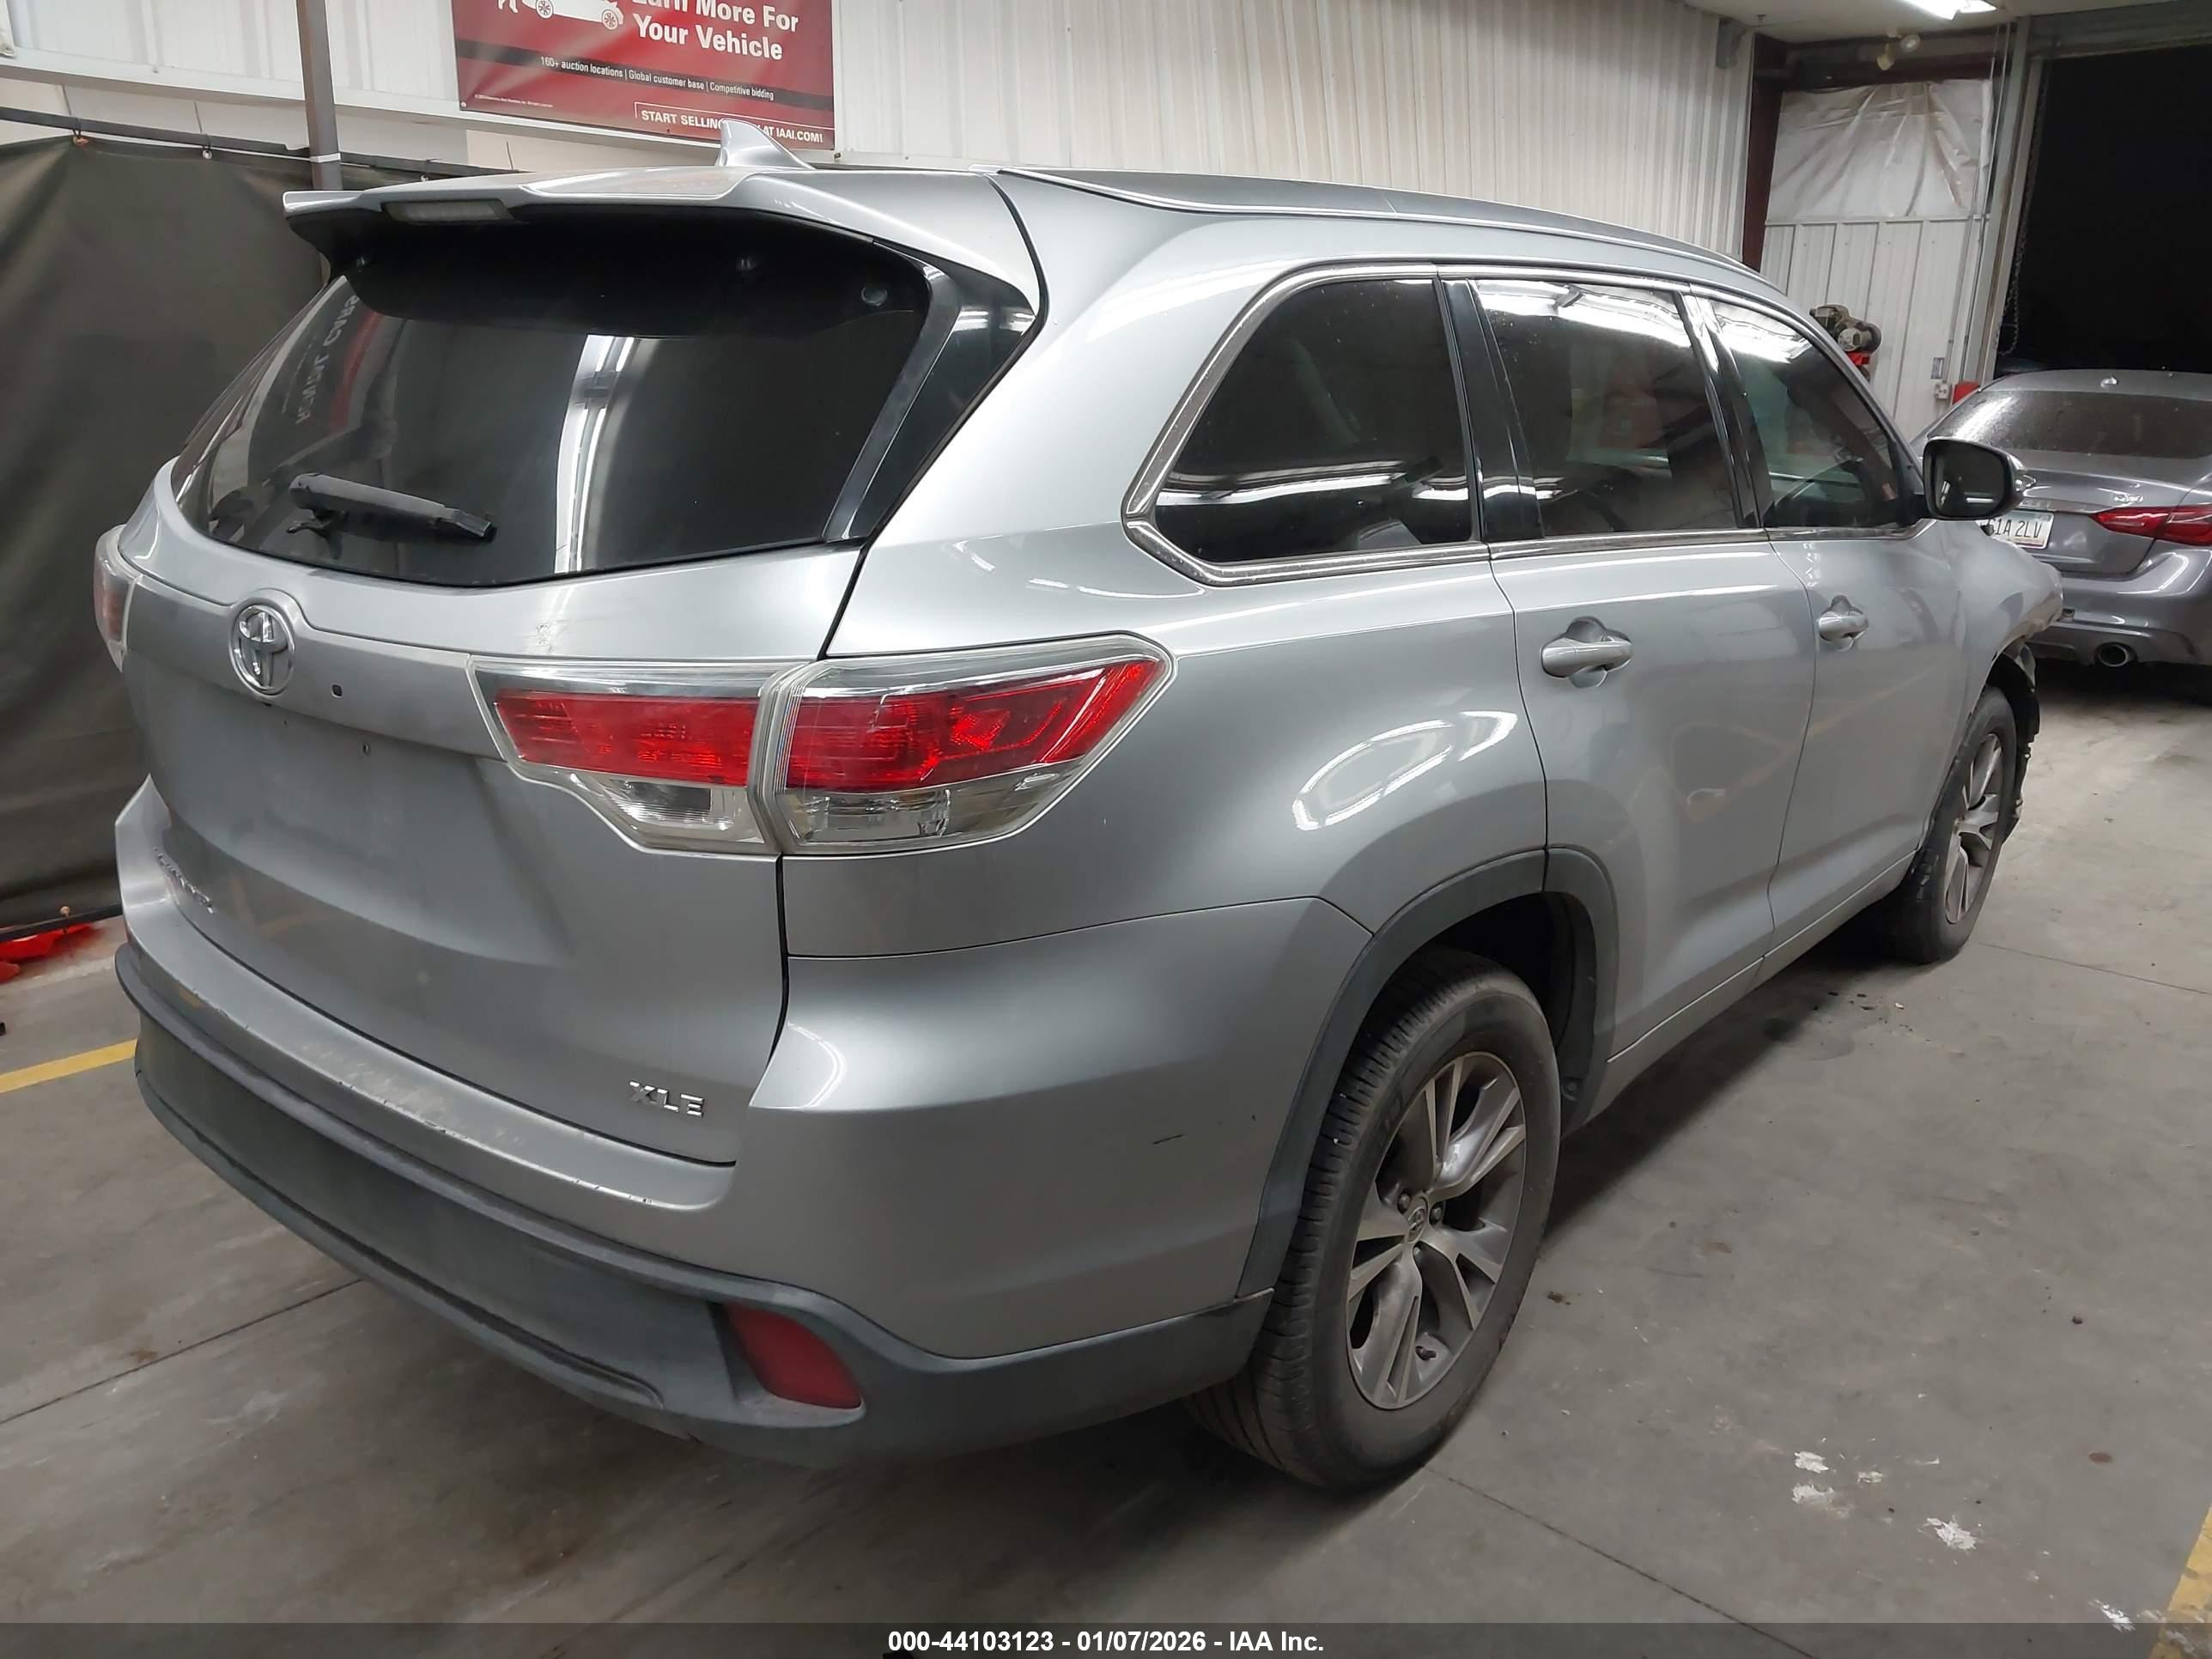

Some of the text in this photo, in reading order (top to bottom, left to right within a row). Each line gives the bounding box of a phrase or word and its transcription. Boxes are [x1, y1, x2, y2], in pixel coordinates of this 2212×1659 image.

[696, 0, 756, 25] More
[763, 5, 799, 32] For
[633, 13, 782, 60] Your Vehicle
[540, 56, 559, 68] 160+
[561, 61, 589, 73] auction
[590, 64, 623, 77] locations
[629, 70, 652, 82] Global
[653, 76, 686, 88] customer
[687, 78, 704, 90] base
[709, 82, 750, 97] Competitive
[751, 88, 774, 101] bidding
[641, 110, 678, 124] START
[763, 125, 775, 137] AT
[775, 126, 823, 143] IAAI.COM!
[2014, 520, 2043, 538] 2LV
[629, 1080, 705, 1117] XLE
